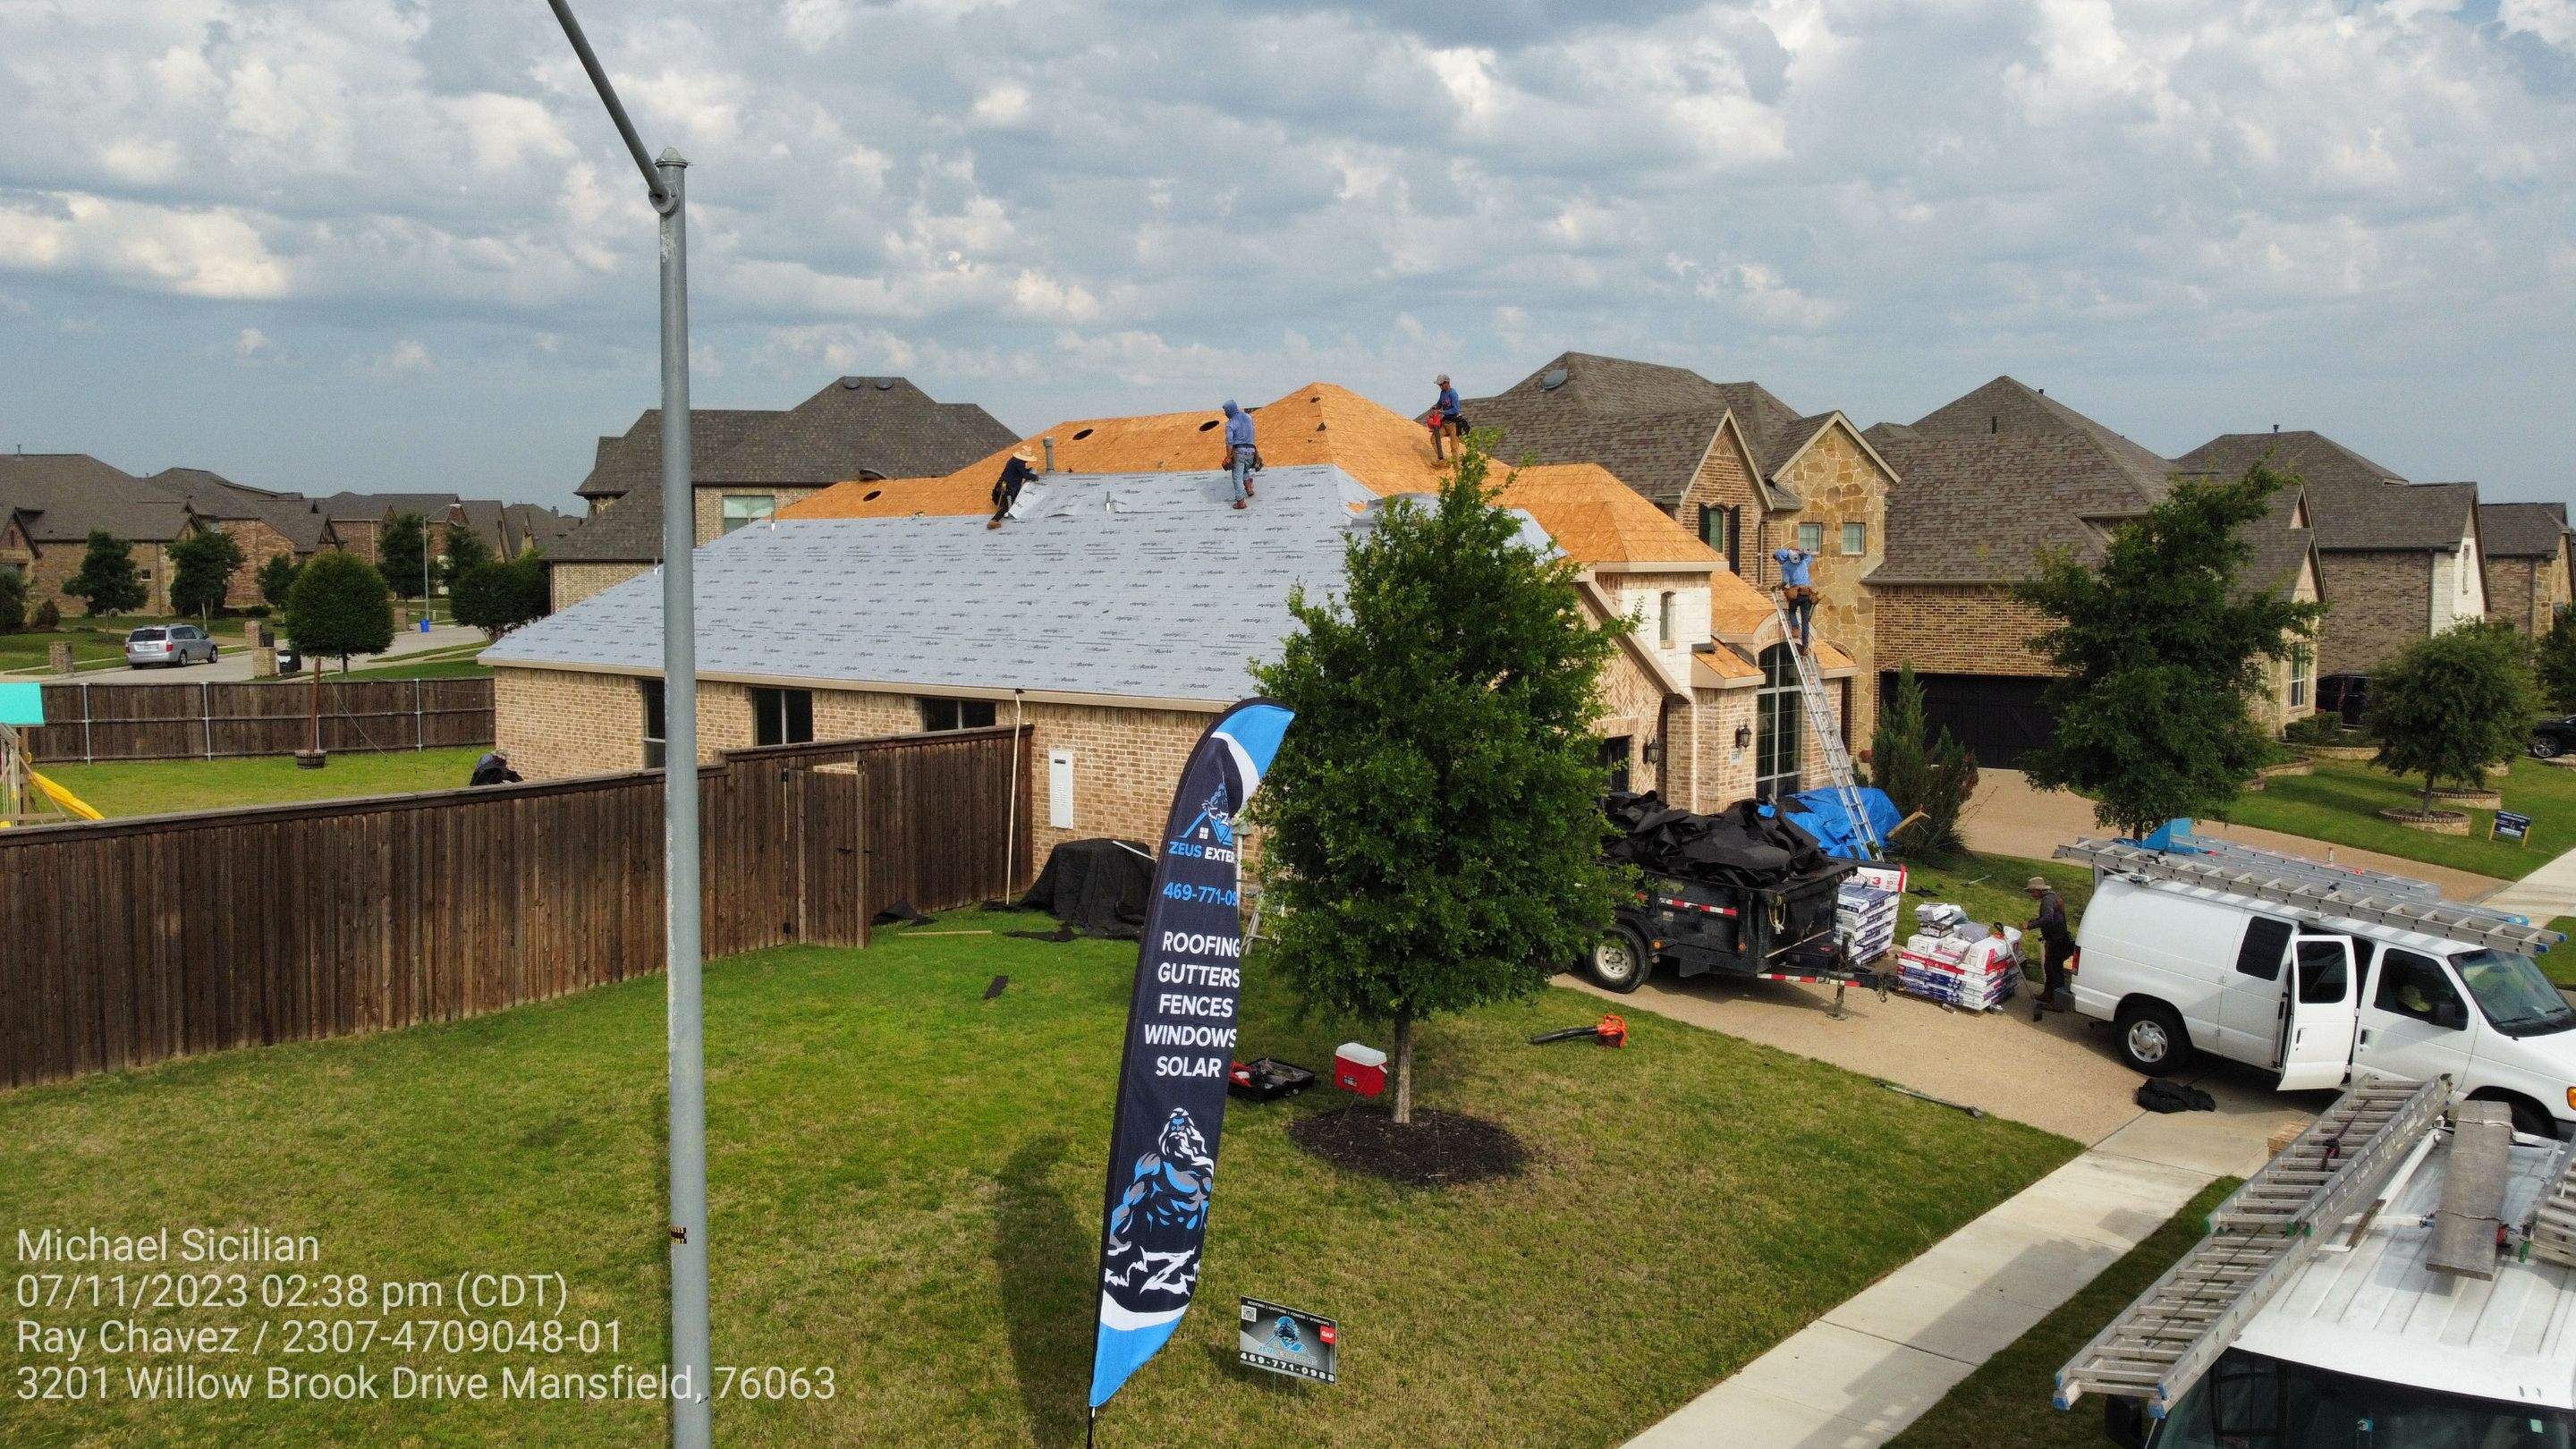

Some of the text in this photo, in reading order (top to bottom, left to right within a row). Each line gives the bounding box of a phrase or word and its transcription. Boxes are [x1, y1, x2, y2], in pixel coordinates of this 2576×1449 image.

[1168, 841, 1202, 858] ZEUS
[1872, 877, 1881, 886] 3
[1162, 931, 1241, 958] ROOFING
[1157, 962, 1241, 988] GUTTERS
[1158, 994, 1233, 1018] FENCES
[1144, 1024, 1237, 1048] WINDOWS
[1155, 1055, 1222, 1078] SOLAR
[1240, 1352, 1335, 1383] 469-771-0988
